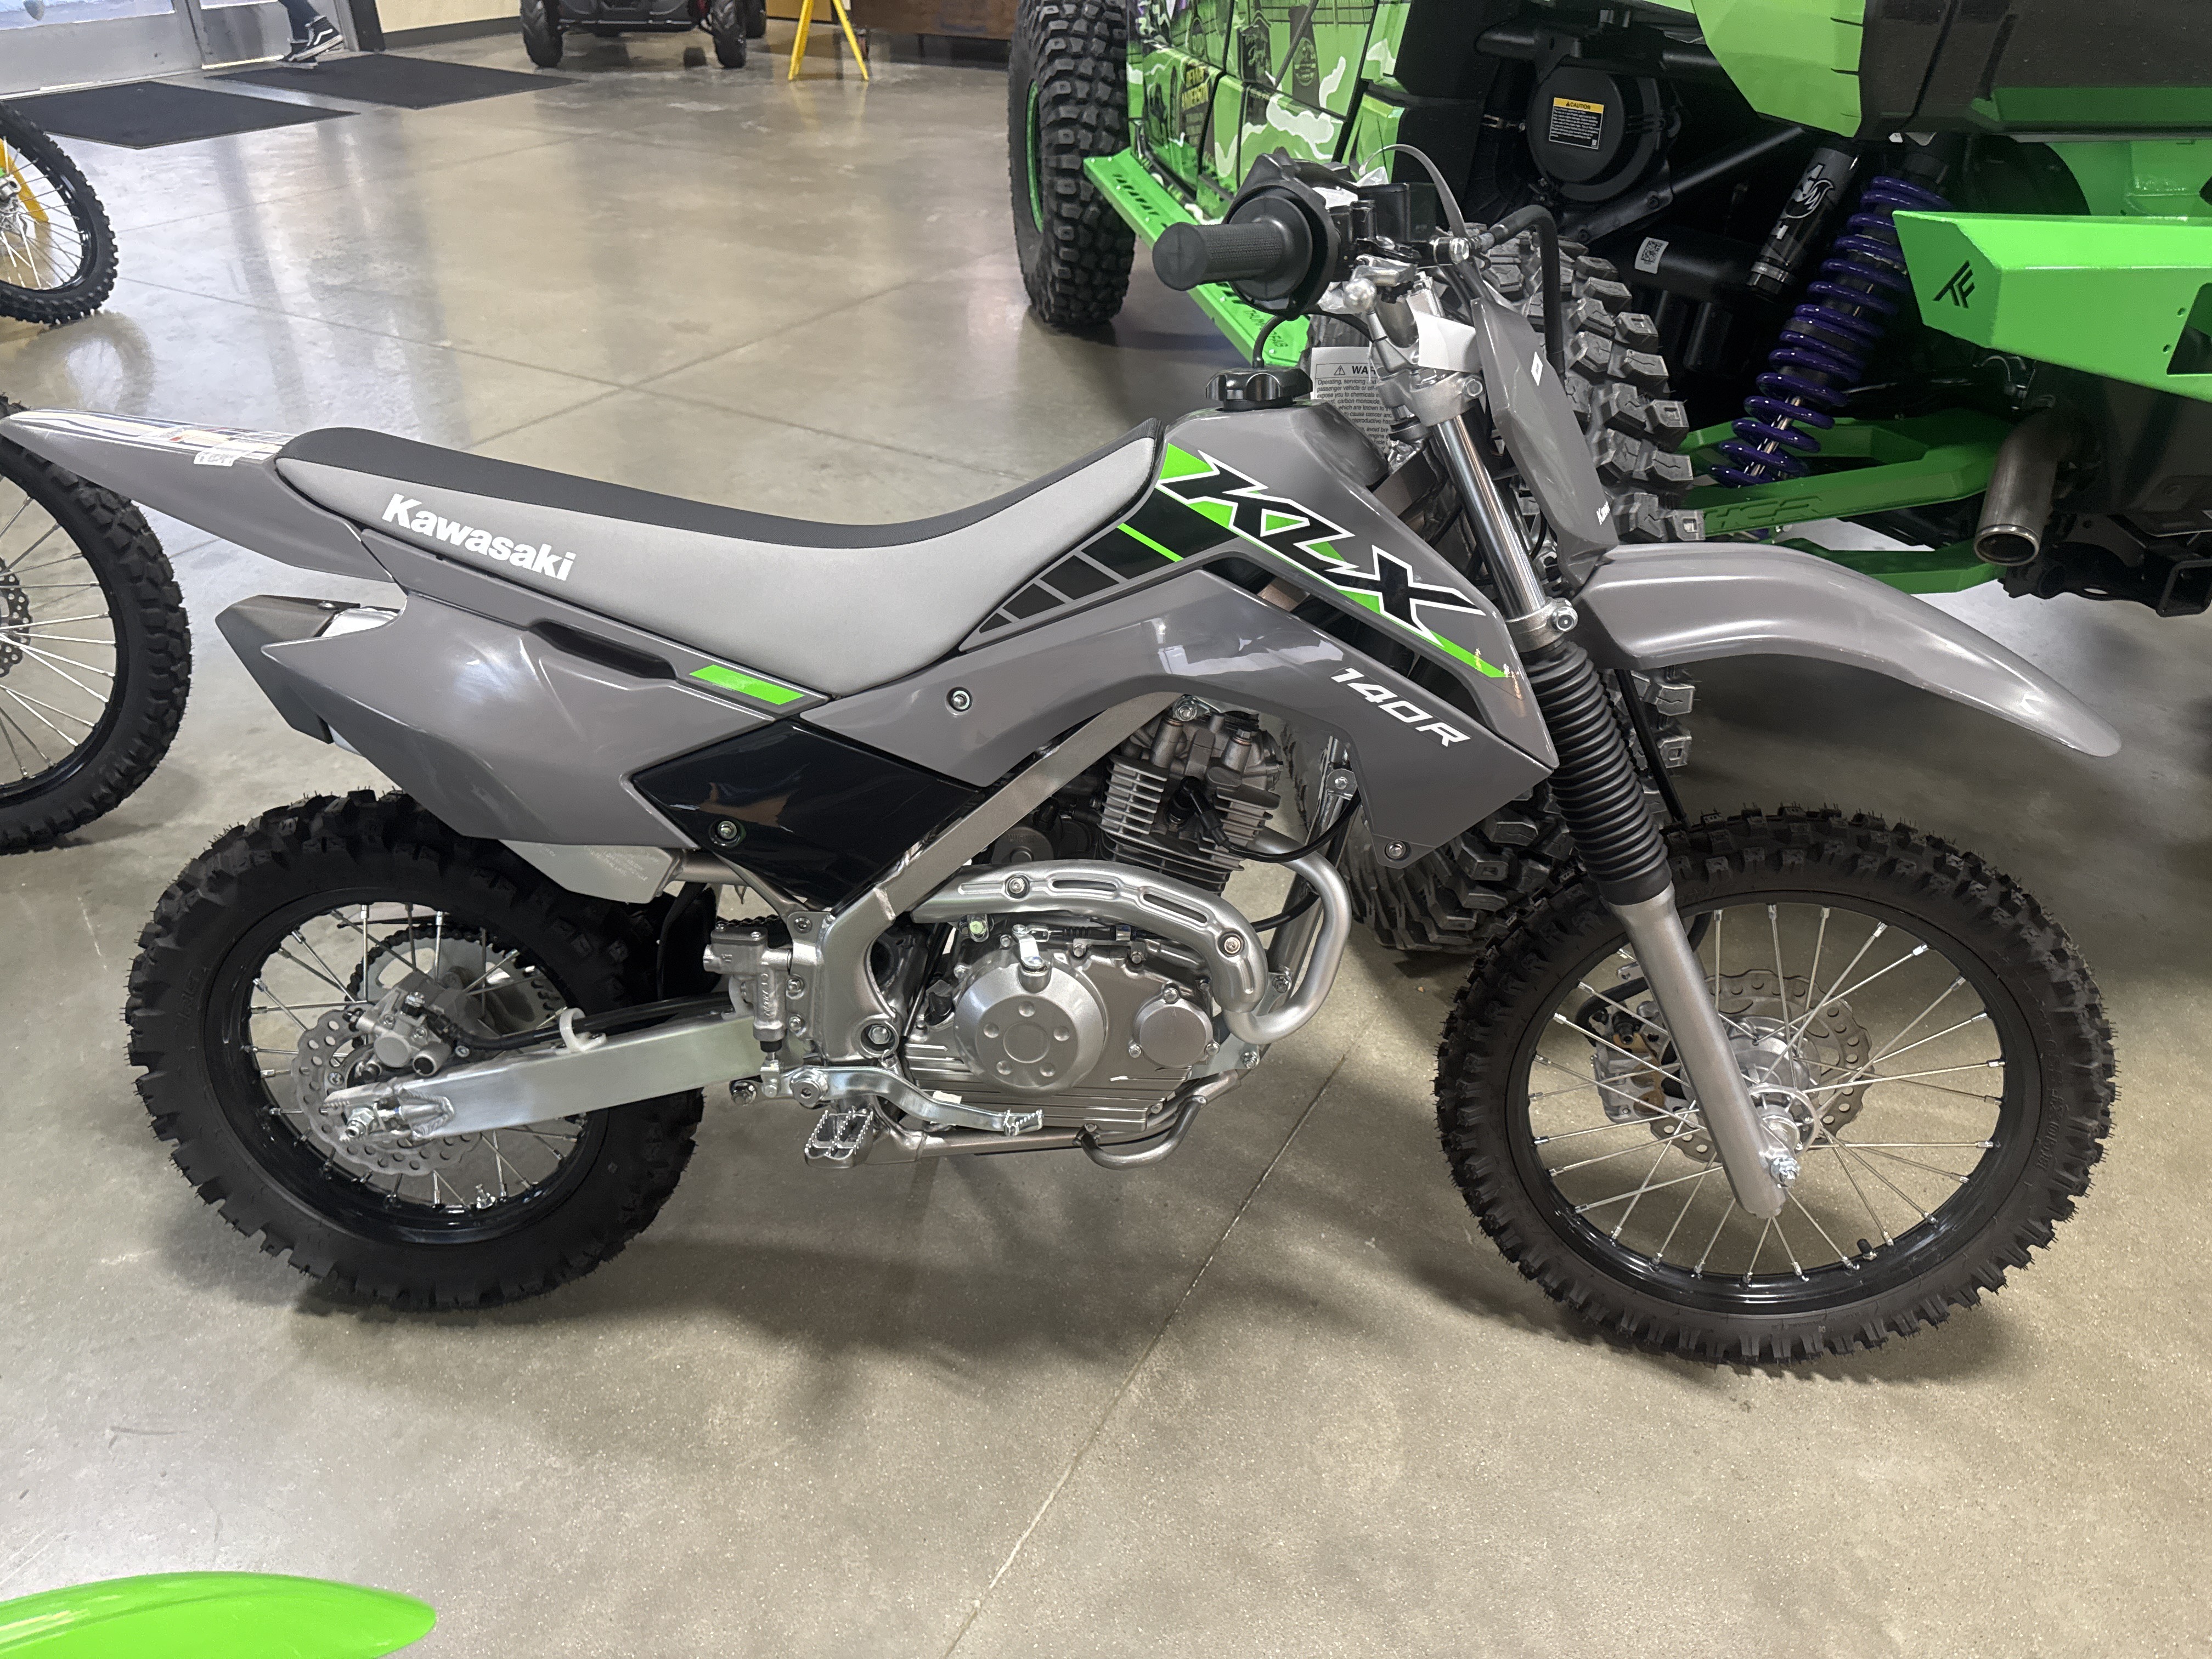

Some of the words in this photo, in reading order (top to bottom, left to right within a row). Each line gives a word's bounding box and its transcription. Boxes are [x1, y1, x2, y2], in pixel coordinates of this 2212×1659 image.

[1570, 101, 1591, 110] CAUTION
[1932, 259, 1975, 309] TF
[1352, 365, 1376, 375] WAR
[382, 493, 577, 581] Kawasaki
[1157, 450, 1486, 647] KLX
[1330, 668, 1471, 747] 140R
